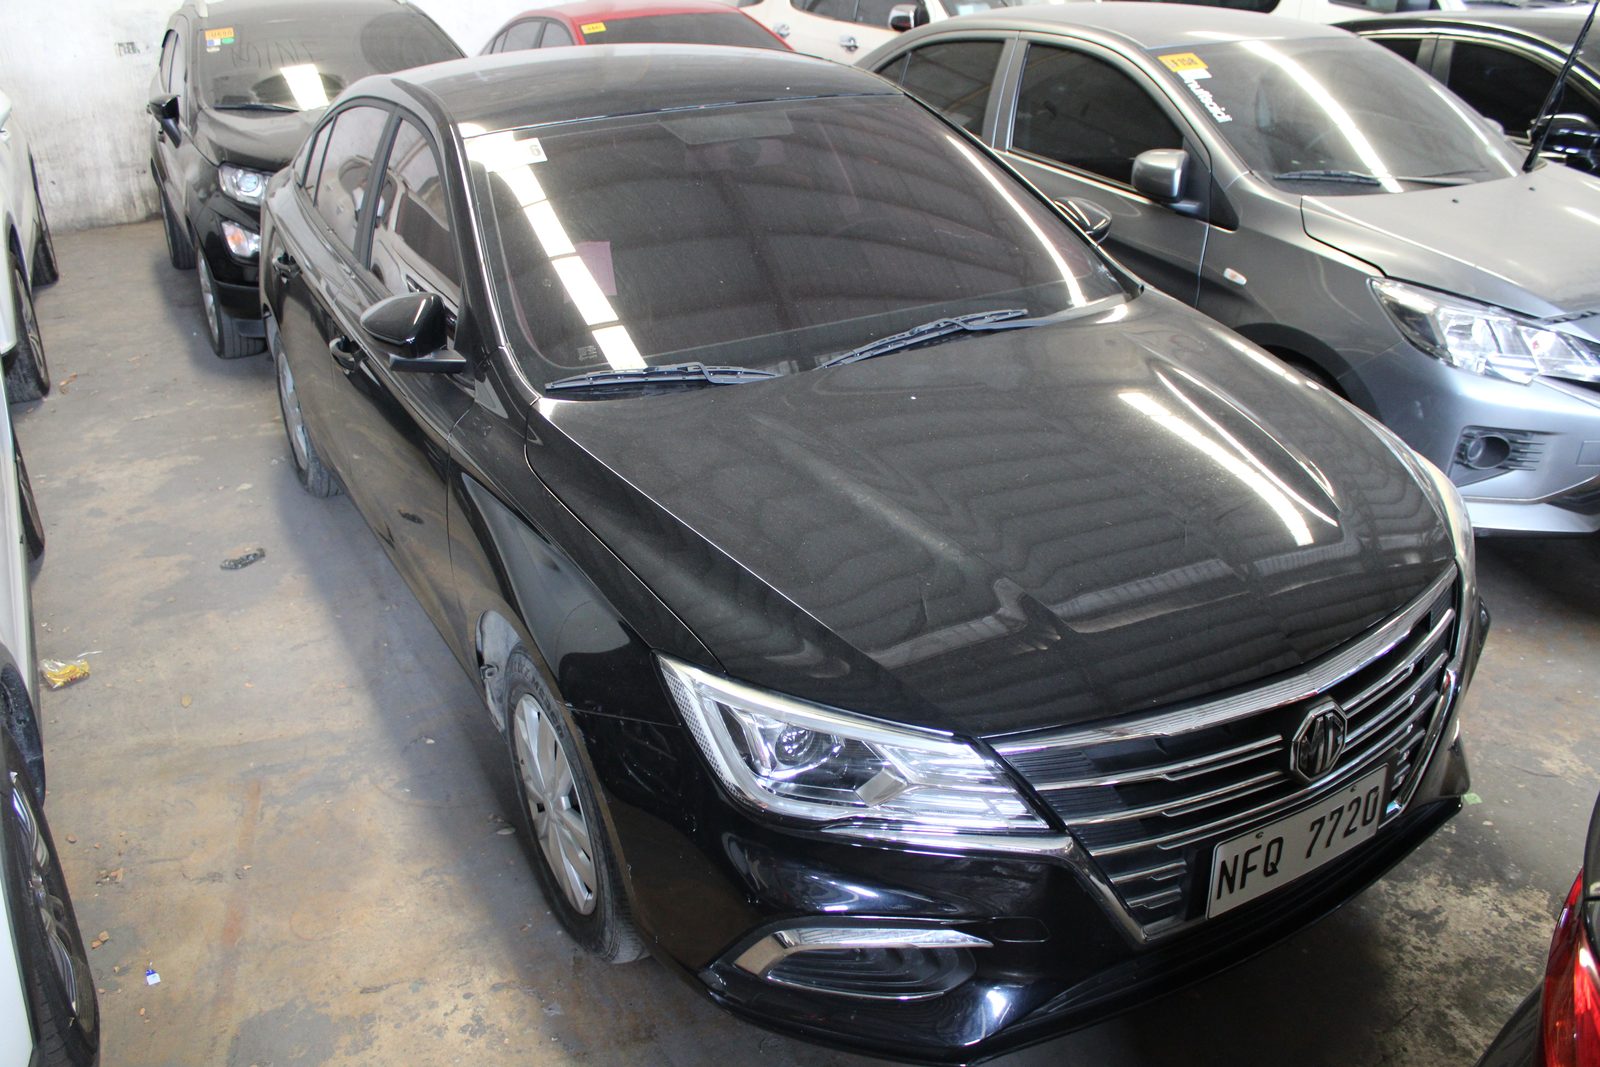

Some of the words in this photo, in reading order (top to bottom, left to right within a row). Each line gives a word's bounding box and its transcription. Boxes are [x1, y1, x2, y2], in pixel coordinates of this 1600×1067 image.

[1297, 710, 1346, 775] MG
[1216, 836, 1284, 900] NFQ
[1305, 785, 1380, 860] 7720
